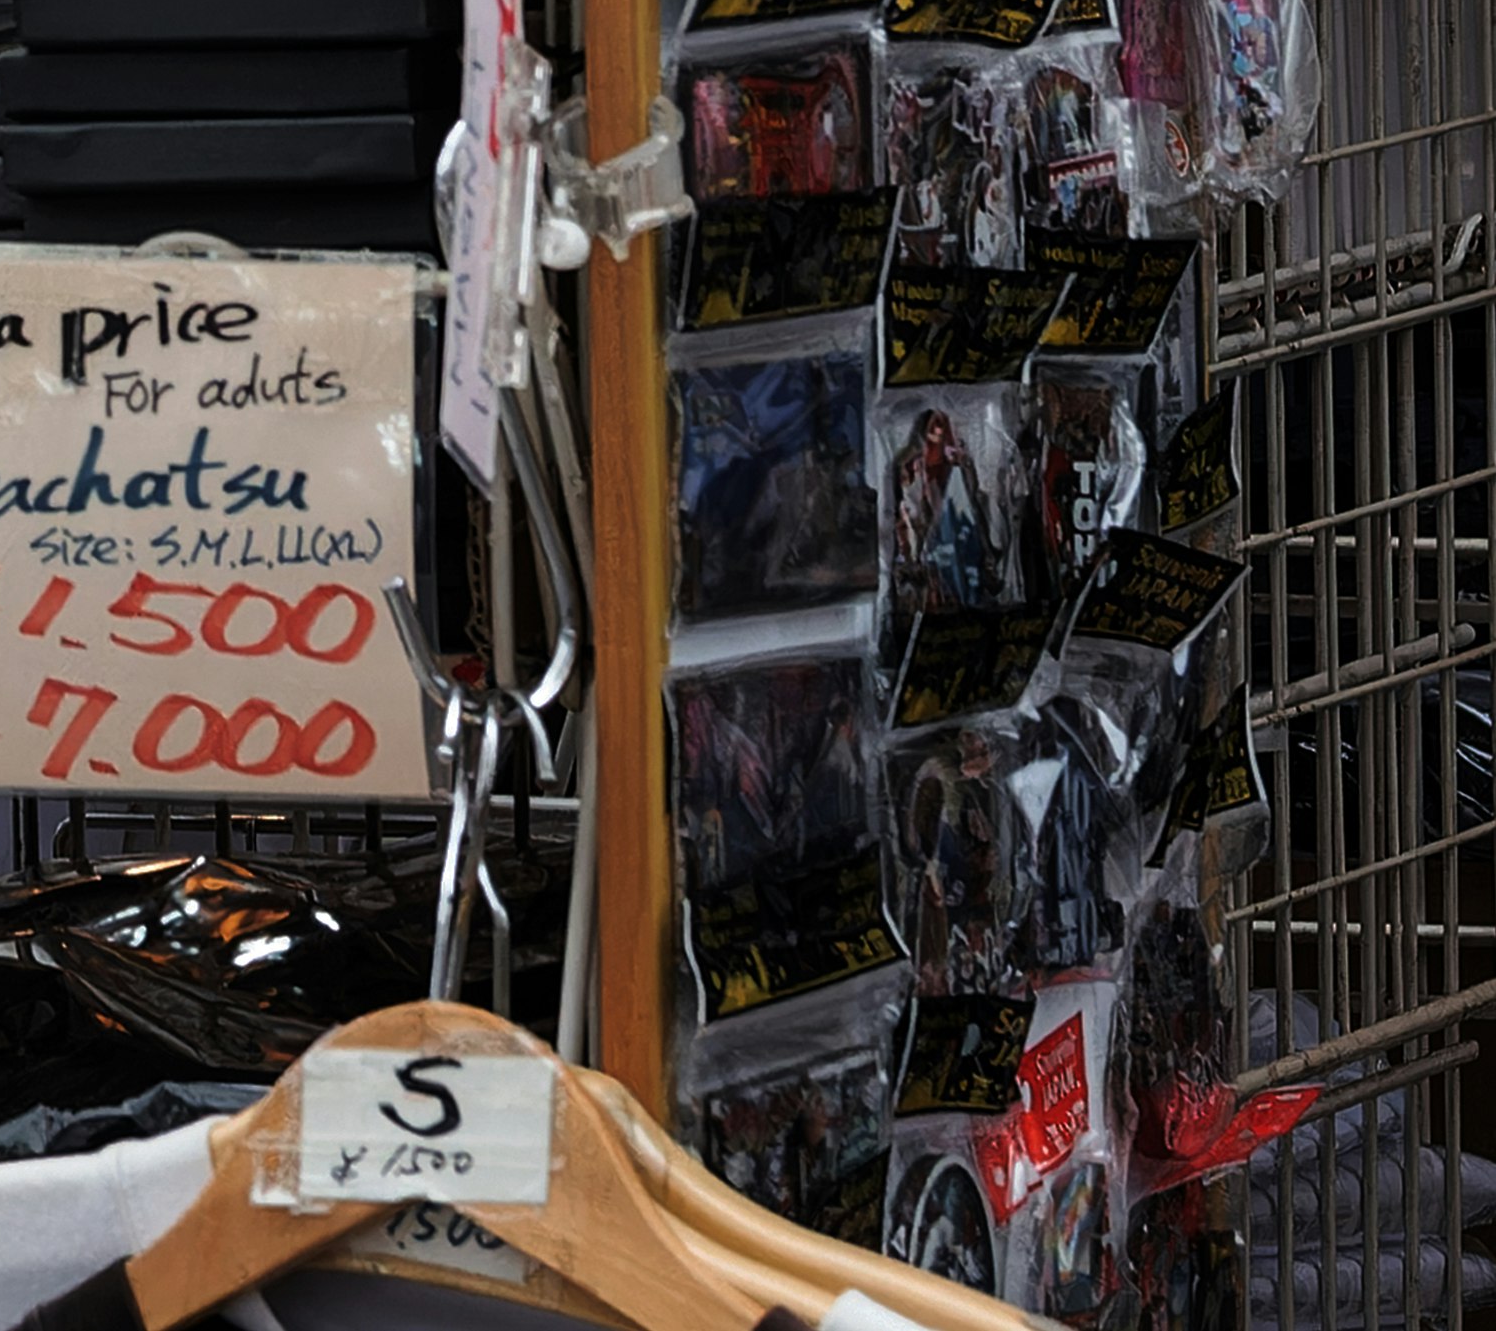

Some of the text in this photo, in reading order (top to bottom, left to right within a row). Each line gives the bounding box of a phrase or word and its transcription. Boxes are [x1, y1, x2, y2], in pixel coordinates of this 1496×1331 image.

[61, 282, 260, 386] price
[102, 347, 347, 418] For aduts
[378, 1055, 464, 1138] S
